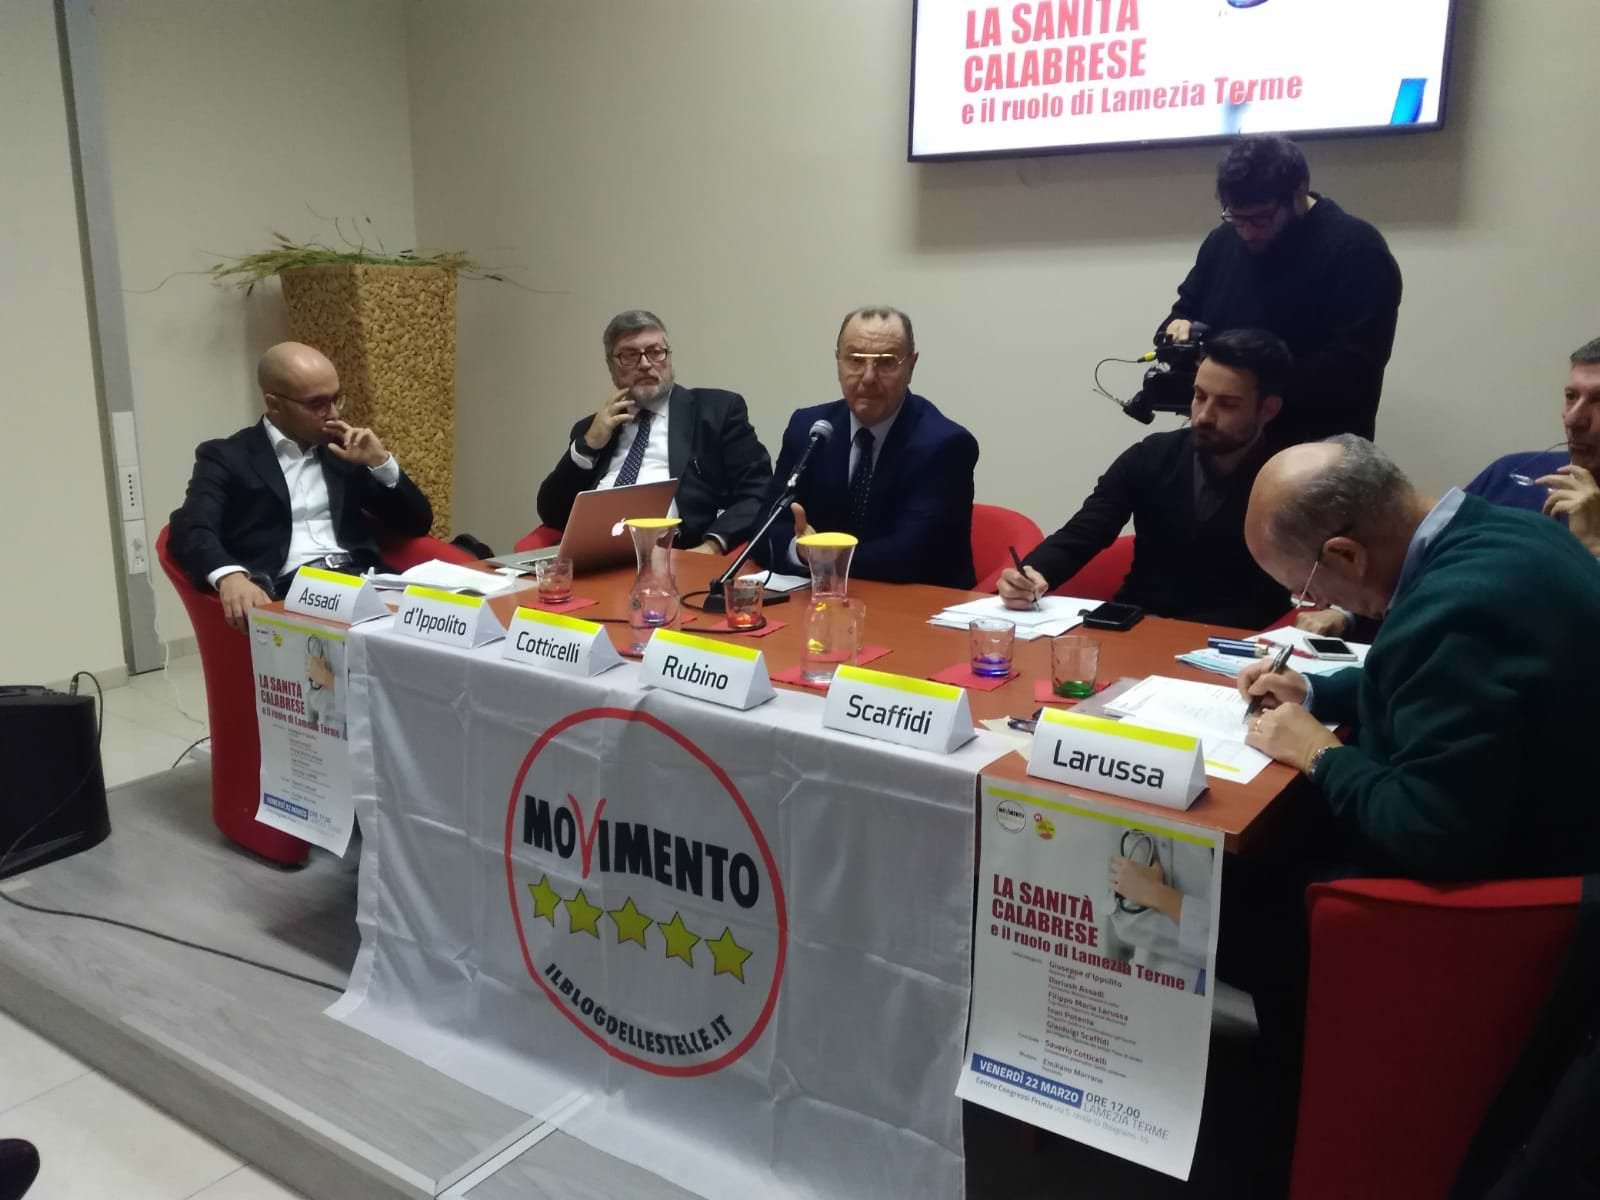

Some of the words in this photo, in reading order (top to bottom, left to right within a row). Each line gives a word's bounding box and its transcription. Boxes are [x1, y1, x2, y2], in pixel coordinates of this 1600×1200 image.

[966, 7, 1002, 49] LA
[964, 38, 1147, 93] CALABRESE
[961, 103, 975, 125] e
[980, 97, 996, 123] il
[1001, 92, 1064, 122] ruolo
[1070, 88, 1095, 116] di
[1101, 81, 1205, 113] Lamezia
[1214, 75, 1304, 105] Terme
[299, 587, 342, 611] Assadi
[404, 608, 467, 636] d'Ippolito
[516, 631, 580, 664] Cotticelli
[259, 674, 269, 689] LA
[662, 655, 729, 690] Rubino
[261, 690, 305, 715] CALABRESE
[846, 694, 933, 735] Scaffidi
[1052, 739, 1165, 789] Larussa
[523, 793, 760, 908] MOVIMENTO
[993, 874, 1014, 901] LA
[1020, 882, 1094, 922] SANITÀ
[992, 899, 1098, 948] CALABRESE
[991, 924, 999, 937] e
[1002, 925, 1011, 941] il
[1014, 931, 1050, 952] ruolo
[1055, 943, 1068, 959] di
[1072, 946, 1132, 976] Lamezia
[1136, 964, 1186, 991] Terme
[1049, 961, 1083, 977] Giuseppe
[1048, 992, 1073, 1006] Filippo
[1075, 1000, 1096, 1012] Maria
[1098, 1006, 1129, 1021] Larussa
[1079, 985, 1104, 998] Assadi
[544, 963, 733, 1056] ILBLOGDELLESTELLE.IT
[1045, 1040, 1073, 1054] Saverio
[1074, 1049, 1107, 1065] Cotticelli
[1080, 1031, 1110, 1047] Scaffidi
[976, 1076, 997, 1091] Centro
[979, 1060, 1024, 1083] VENERDÌ
[1025, 1076, 1038, 1089] 22
[1040, 1081, 1079, 1103] MARZO
[1083, 1103, 1129, 1126] LAMEZIA
[1131, 1118, 1169, 1140] TERME
[1085, 1092, 1107, 1107] ORE
[1111, 1101, 1140, 1119] 17.00
